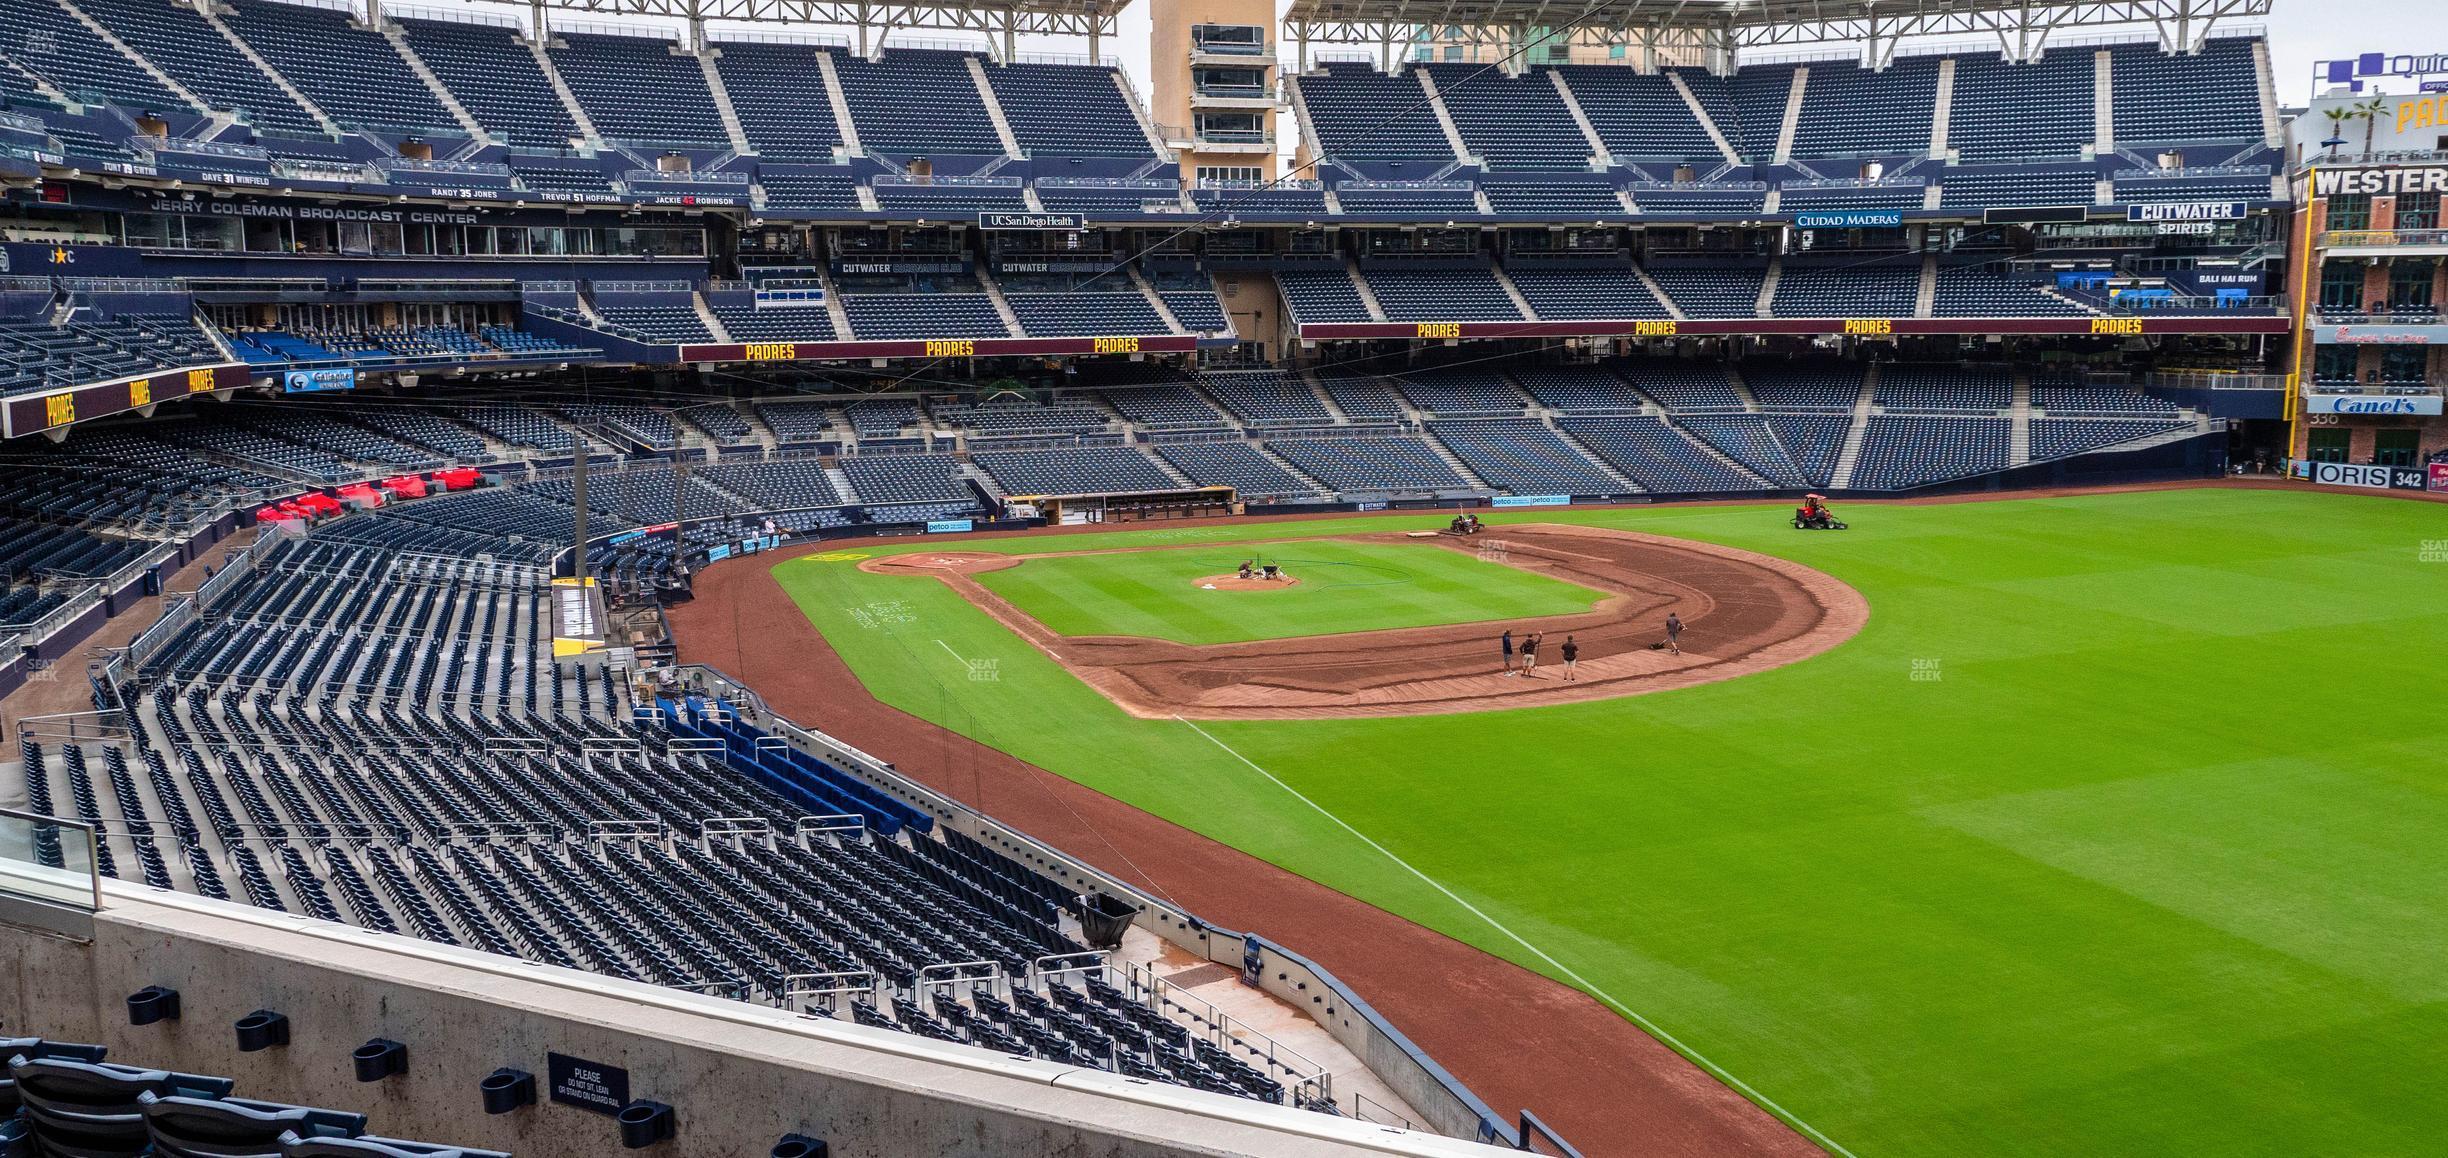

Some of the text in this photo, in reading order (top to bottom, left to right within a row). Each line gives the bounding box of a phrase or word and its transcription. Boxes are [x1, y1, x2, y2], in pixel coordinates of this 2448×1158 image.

[202, 173, 269, 185] DAVE 31 WINFIELD
[2314, 168, 2448, 195] WESTER
[432, 188, 457, 196] RANDY
[460, 189, 471, 198] 35
[542, 193, 570, 201] TREVOR
[573, 194, 584, 202] 51
[682, 197, 694, 205] 42
[151, 200, 477, 224] JERRY COLEMAN BROADCAST CENTER
[2141, 204, 2232, 219] CUTWATER
[991, 216, 1073, 227] UC San Diego Health
[1798, 215, 1899, 226] CIUDAD MADERAS
[2158, 223, 2214, 234] SPIRITS
[843, 264, 890, 272] CUTWATER
[1003, 263, 1047, 272] CUTWATER
[1417, 322, 1460, 337] PADRES
[1636, 321, 1676, 335] PADRES
[1845, 319, 1891, 334] PADRES
[2091, 319, 2142, 333] PADRES
[746, 343, 795, 360] PADRES
[926, 341, 974, 357] PADRES
[1094, 337, 1138, 353] PADRES
[188, 368, 214, 392] PADRES
[130, 380, 151, 404] PADRES
[46, 394, 75, 427] PADRES
[2333, 398, 2416, 413] Canel's
[2320, 465, 2386, 486] ORIS
[2396, 472, 2421, 487] 342
[929, 523, 949, 531] petco
[575, 1068, 600, 1083] PLEASE
[568, 1078, 575, 1086] DO
[576, 1080, 586, 1089] NOT
[596, 1085, 609, 1095] LEAN
[558, 1085, 565, 1094] OR
[566, 1087, 582, 1098] STAND
[583, 1092, 590, 1100] ON
[591, 1094, 608, 1104] GUARD
